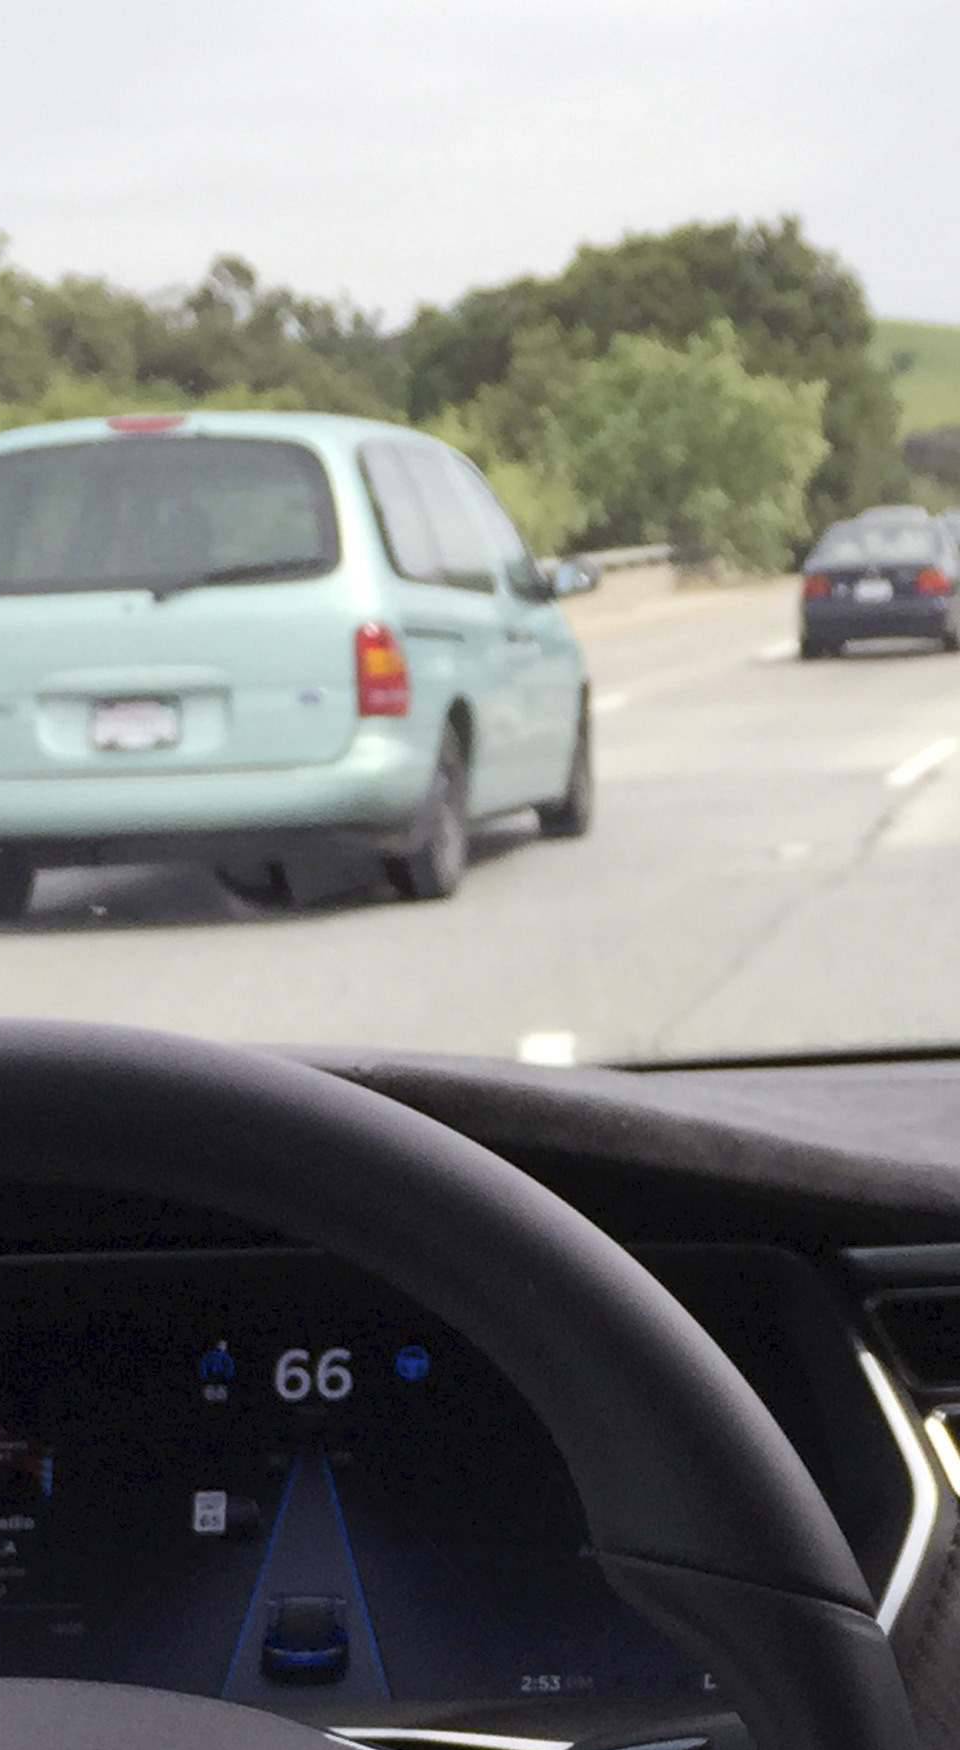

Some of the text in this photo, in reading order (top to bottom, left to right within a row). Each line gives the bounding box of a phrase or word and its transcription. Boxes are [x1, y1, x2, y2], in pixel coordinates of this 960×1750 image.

[275, 1347, 354, 1400] 66
[199, 1513, 221, 1529] 65
[520, 1674, 560, 1691] 2:53
